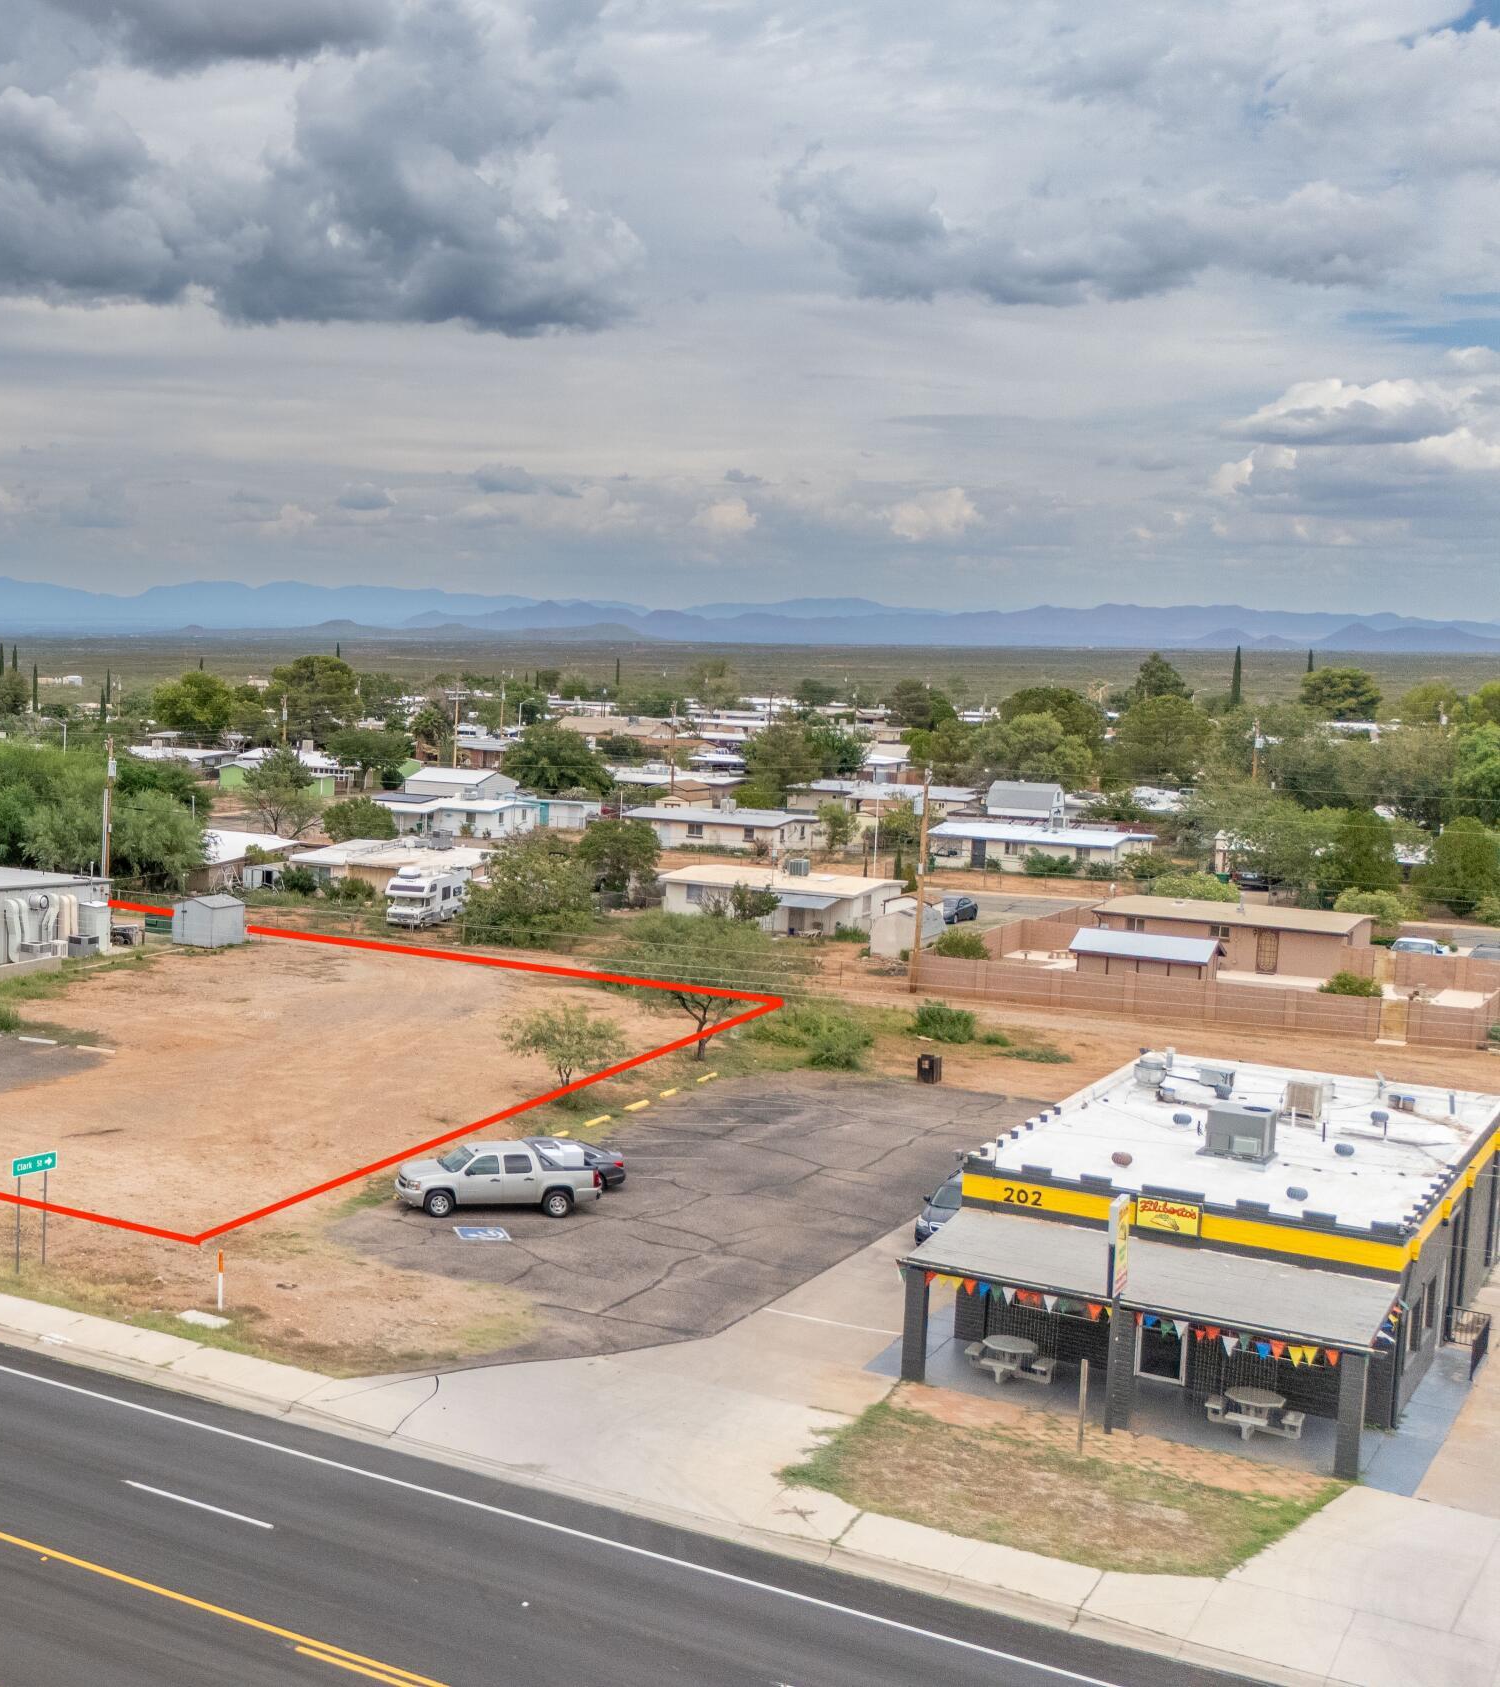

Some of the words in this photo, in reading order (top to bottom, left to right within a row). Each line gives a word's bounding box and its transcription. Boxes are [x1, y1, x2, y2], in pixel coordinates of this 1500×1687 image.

[16, 1161, 33, 1172] Clark
[36, 1159, 43, 1167] St
[1003, 1187, 1043, 1207] 202
[1138, 1199, 1197, 1219] Filiberto's
